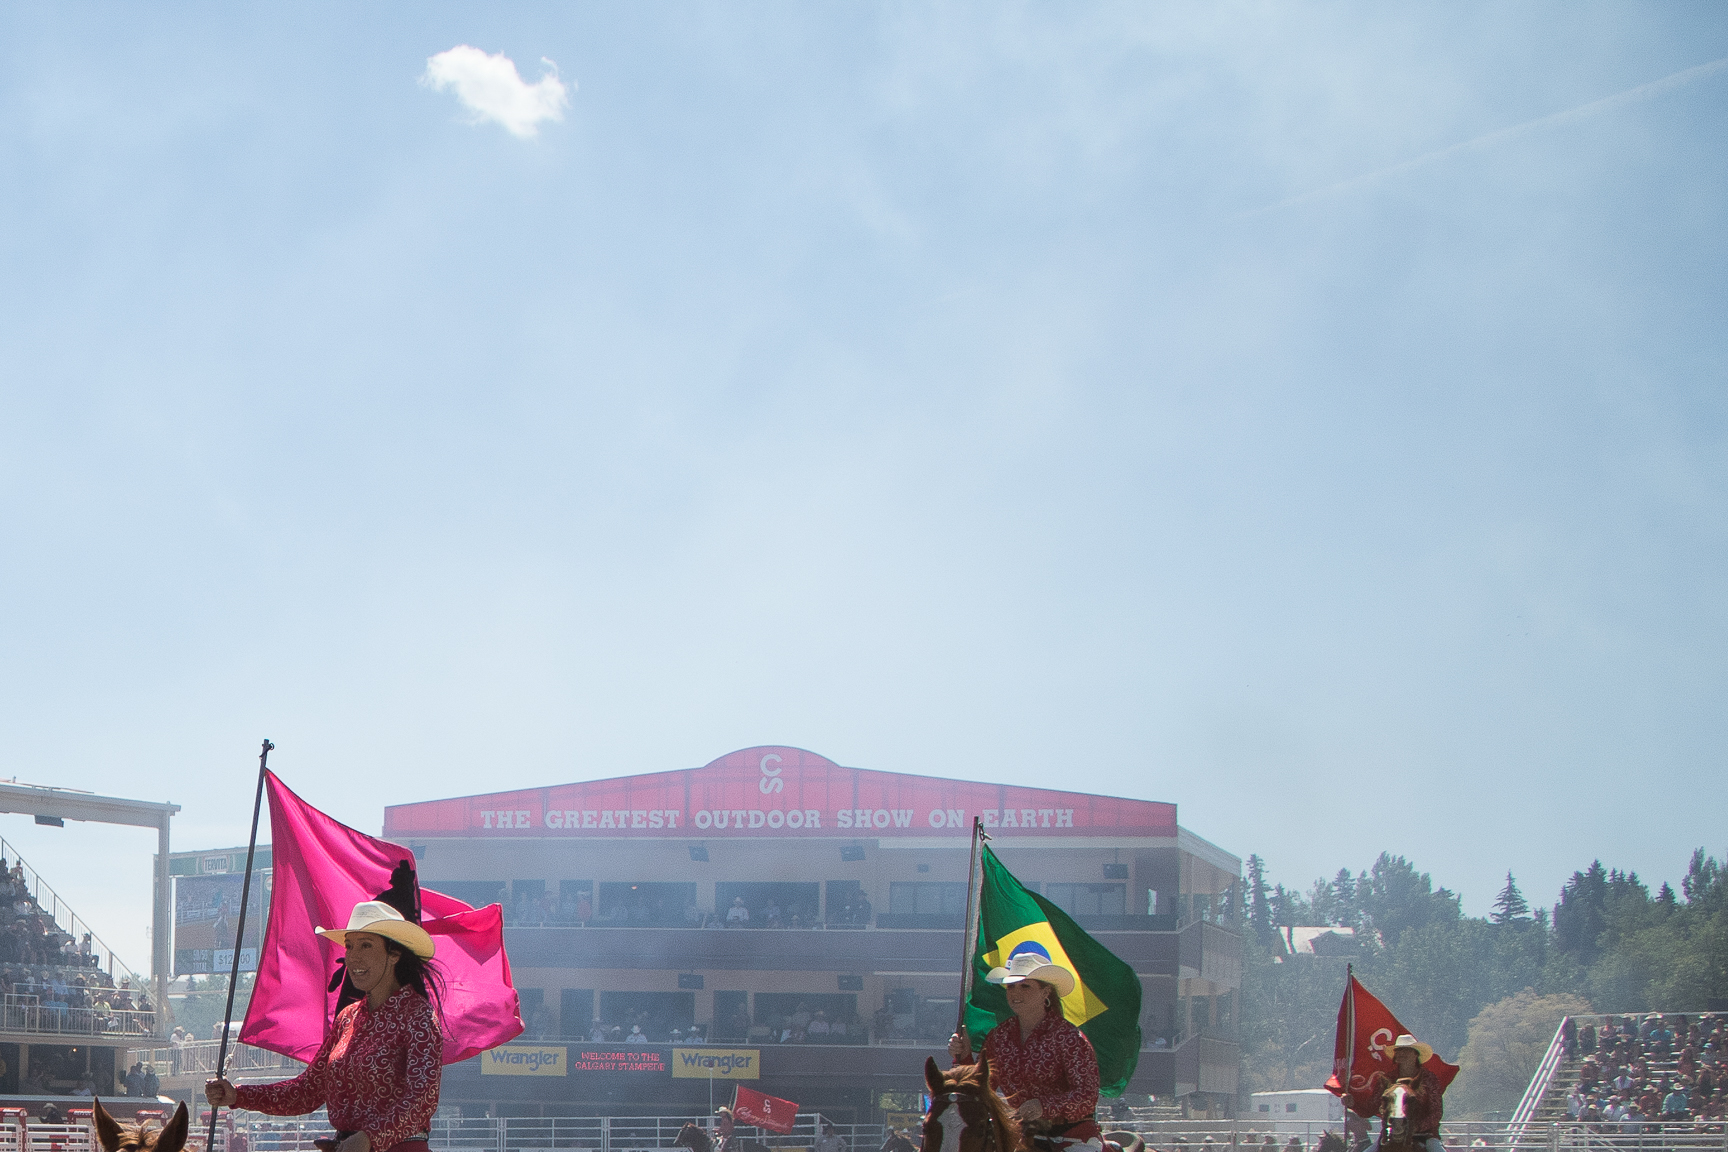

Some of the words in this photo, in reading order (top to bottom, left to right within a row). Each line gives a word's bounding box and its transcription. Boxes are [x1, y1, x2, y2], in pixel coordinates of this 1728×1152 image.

[481, 810, 531, 829] THE
[545, 810, 680, 829] GREATEST
[695, 809, 821, 829] OUTDOOR
[837, 809, 914, 828] SHOW
[928, 809, 965, 828] ON
[983, 809, 1074, 828] EARTH
[490, 1050, 559, 1072] Wrangler
[575, 1061, 616, 1071] CALGARY
[618, 1062, 665, 1072] STAMPEDE
[581, 1052, 626, 1061] WELCOME
[627, 1052, 640, 1061] TO
[641, 1052, 660, 1062] THE
[680, 1052, 752, 1075] Wrangler
